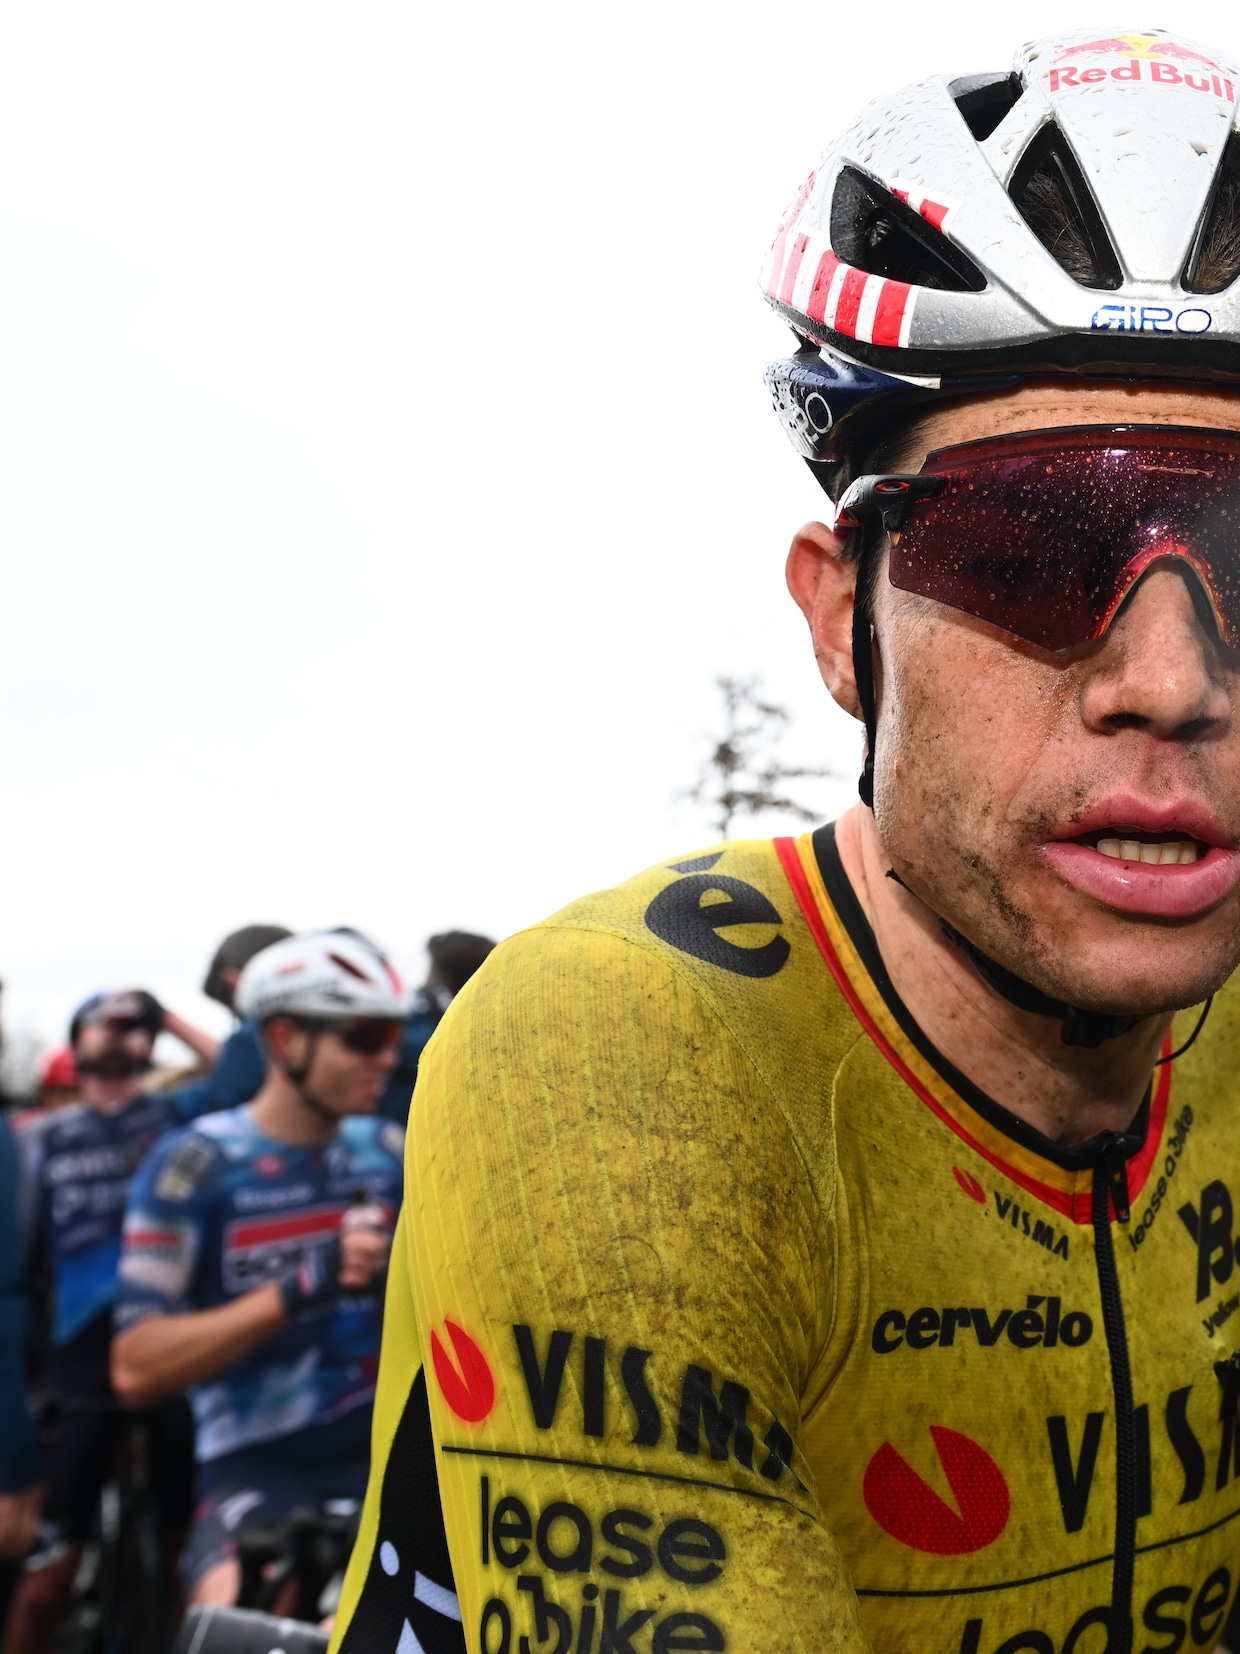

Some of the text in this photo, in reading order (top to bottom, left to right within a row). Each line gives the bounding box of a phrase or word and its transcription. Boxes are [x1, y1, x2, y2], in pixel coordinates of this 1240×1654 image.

[1049, 59, 1235, 104] Red Bull
[1090, 305, 1212, 335] GIRO
[994, 1189, 1069, 1261] VISMA
[1128, 1175, 1168, 1253] lease
[1164, 1154, 1177, 1178] a
[871, 1294, 1093, 1355] cervélo
[480, 1475, 727, 1585] lease
[516, 1574, 726, 1654] bike
[957, 1566, 1231, 1654] ase
